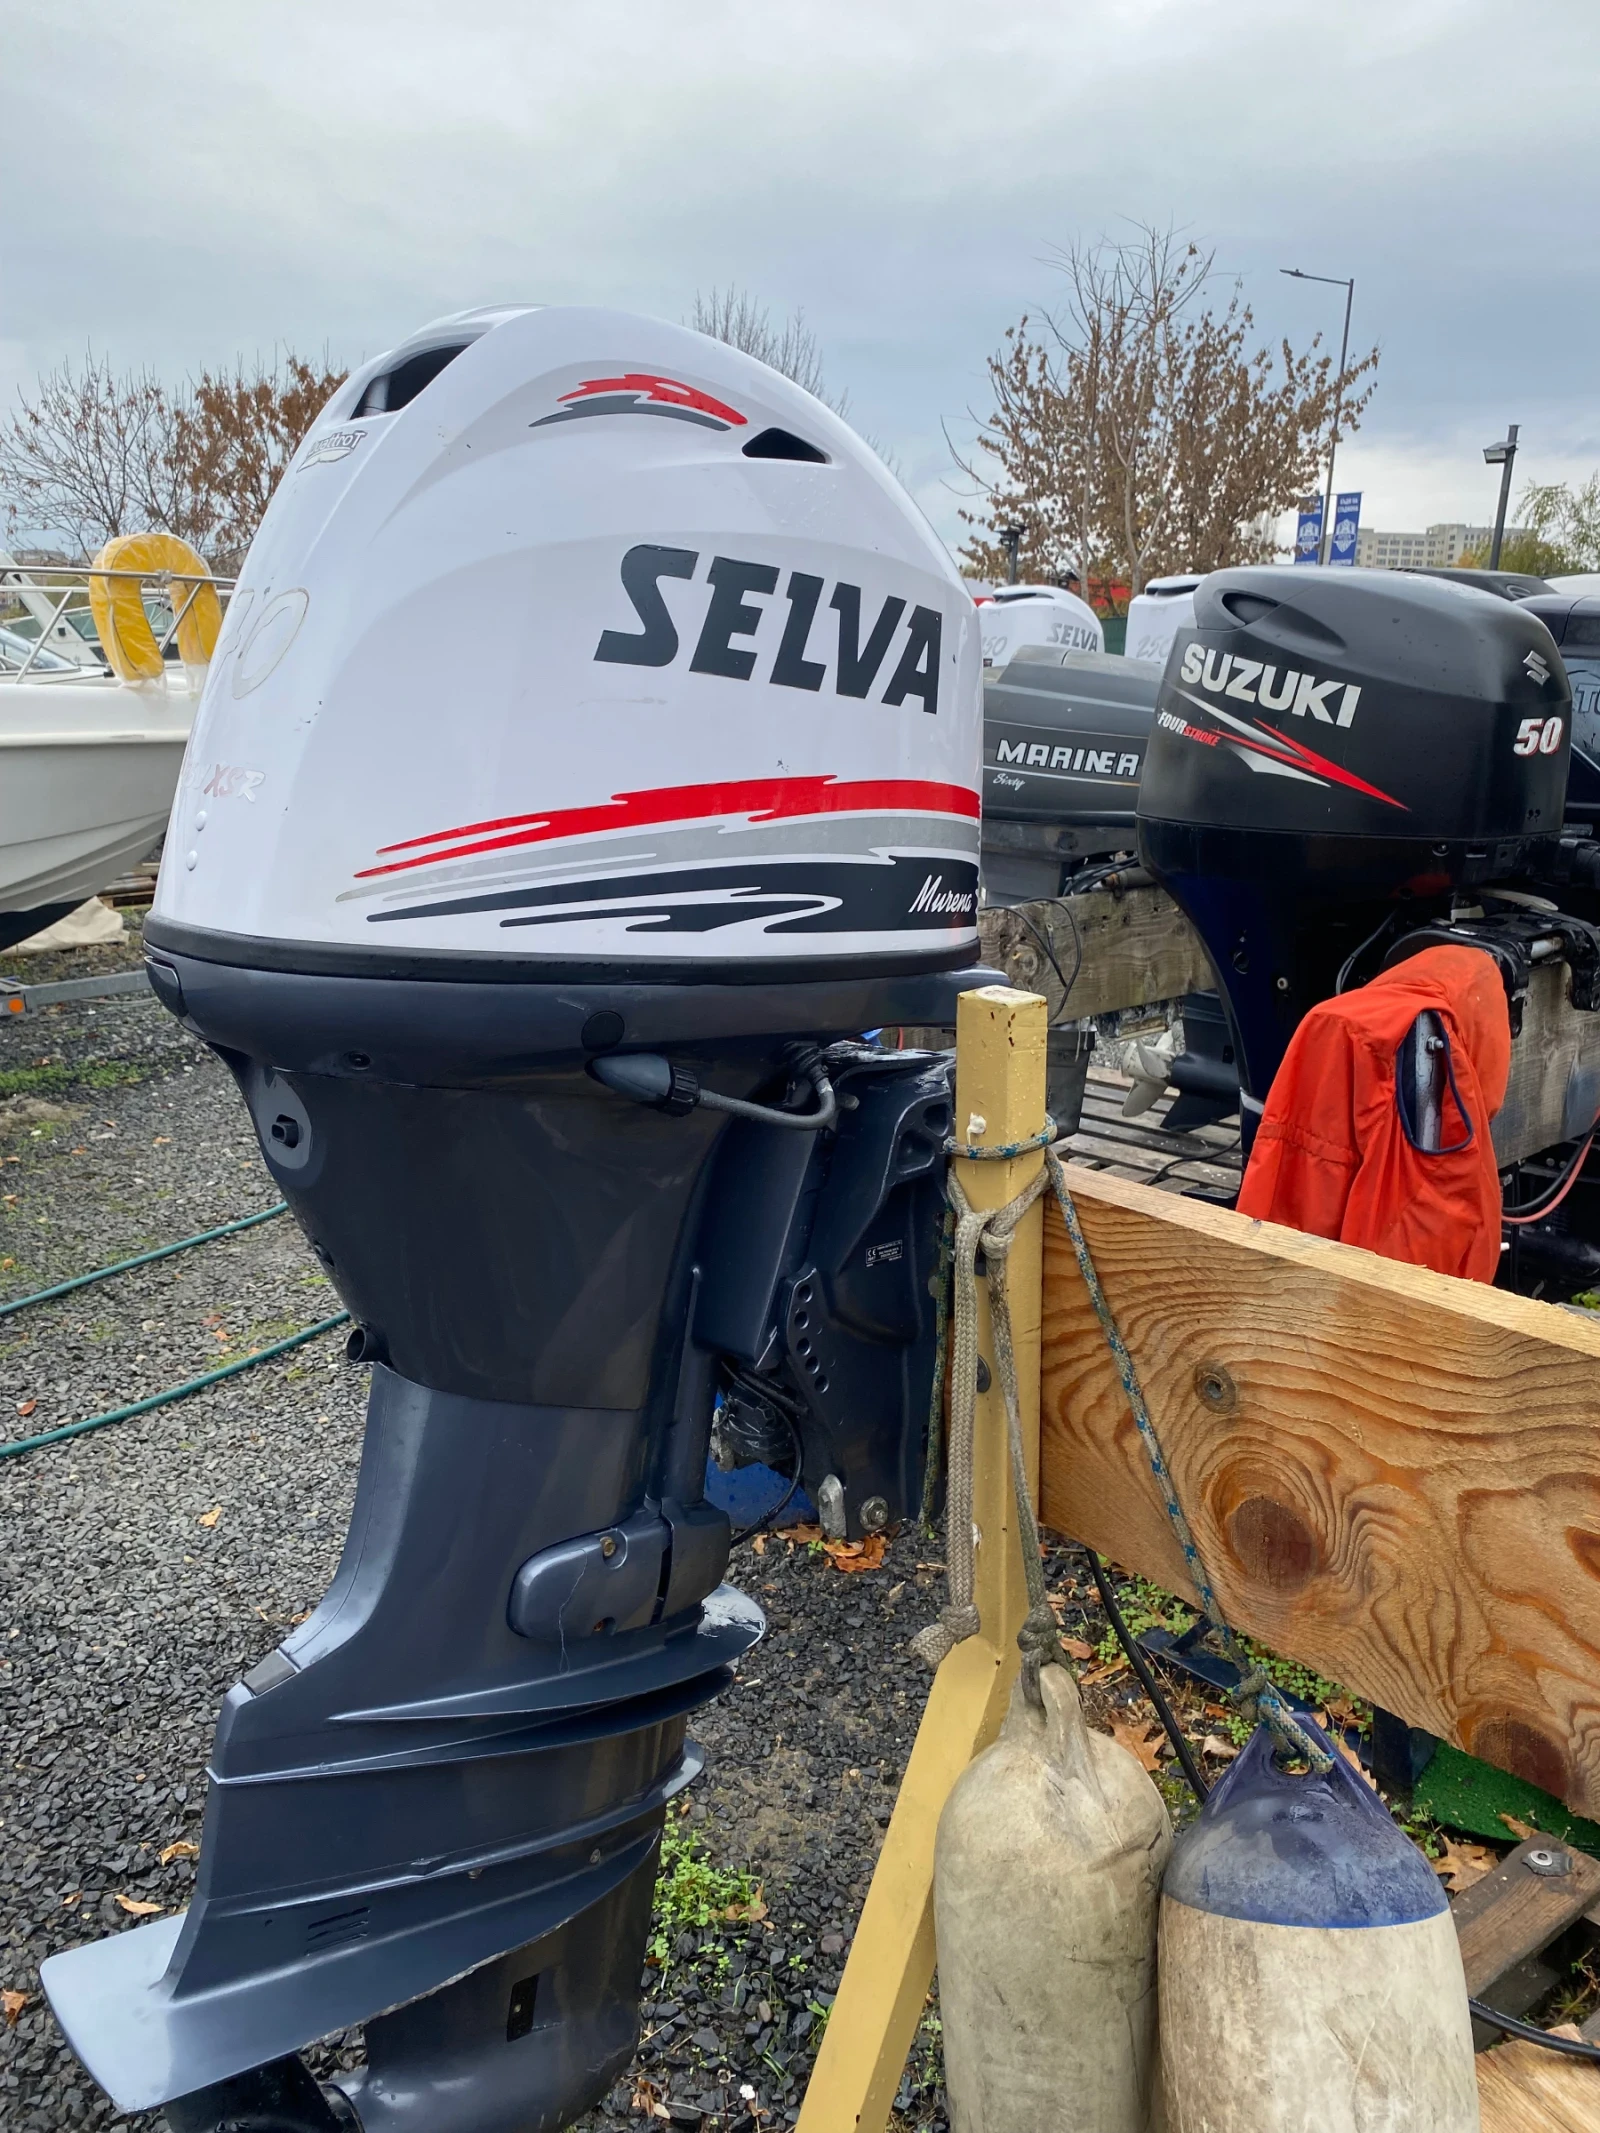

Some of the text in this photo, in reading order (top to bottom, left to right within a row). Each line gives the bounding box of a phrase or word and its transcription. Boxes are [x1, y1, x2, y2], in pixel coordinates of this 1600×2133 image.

[594, 544, 943, 715] SELVA
[1046, 622, 1098, 652] SELVA
[1180, 643, 1362, 728] SUZUKI
[1513, 717, 1564, 756] 50
[995, 738, 1140, 777] MARINER
[993, 773, 1026, 791] Sixty
[908, 875, 973, 913] Murena
